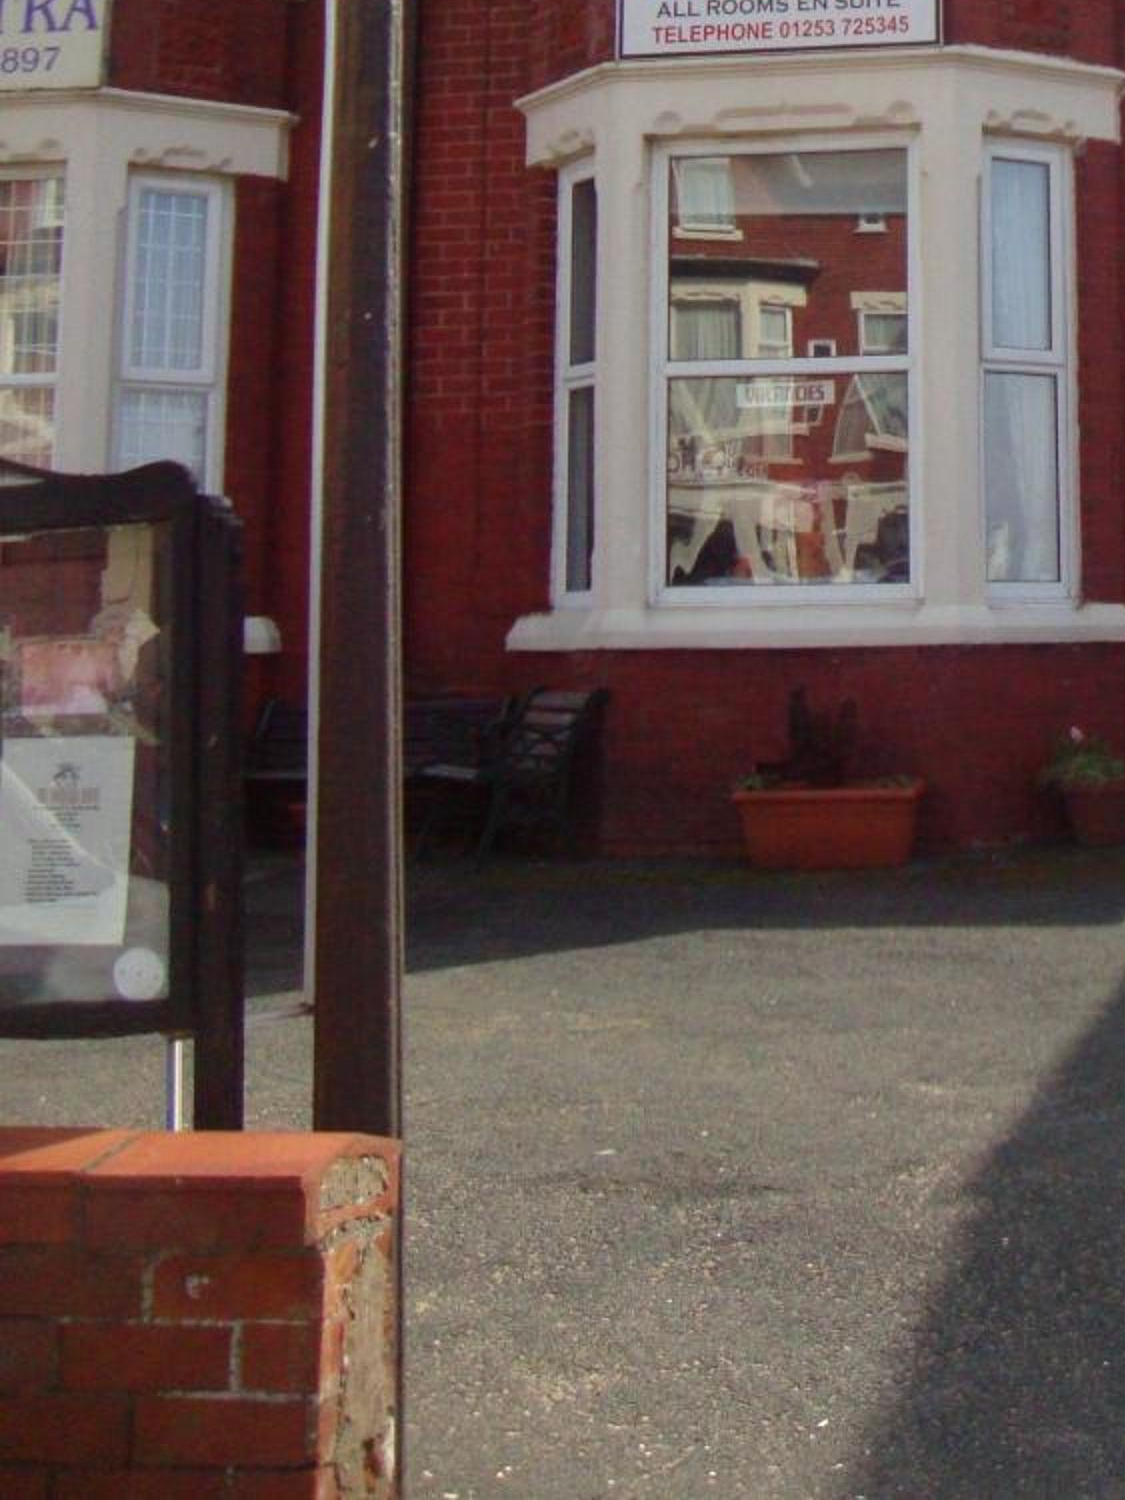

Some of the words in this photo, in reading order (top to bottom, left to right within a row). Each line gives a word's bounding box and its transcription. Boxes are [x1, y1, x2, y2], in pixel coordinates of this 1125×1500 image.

[656, 0, 700, 18] ALL
[652, 22, 772, 44] TELEPHONE
[779, 19, 835, 38] 01253
[842, 15, 909, 35] 725345
[1, 47, 61, 73] 897
